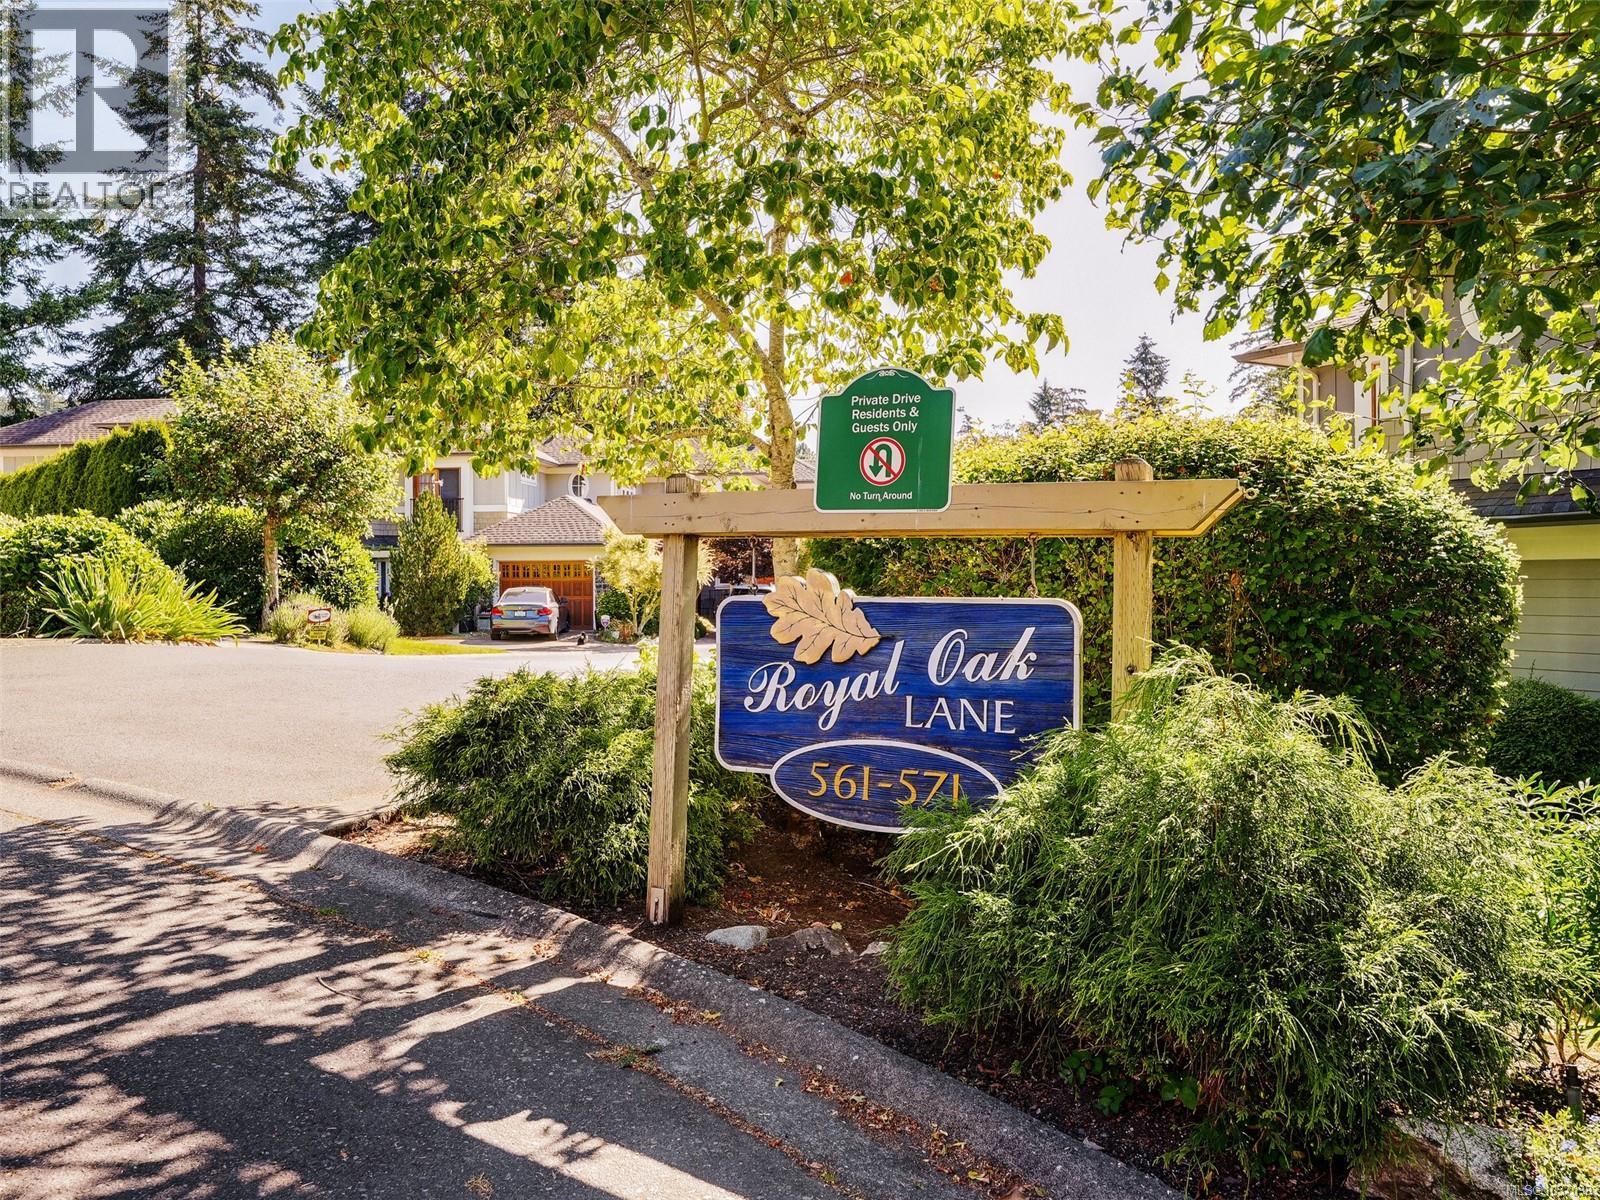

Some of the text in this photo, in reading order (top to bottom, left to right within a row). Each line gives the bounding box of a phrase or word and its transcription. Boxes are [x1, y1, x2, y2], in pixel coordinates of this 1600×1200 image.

[851, 393, 921, 406] Private Drive
[851, 406, 919, 420] Residents &
[851, 420, 918, 433] Guests Only
[849, 491, 913, 501] No Turn Around
[743, 626, 1039, 732] Royal Oak
[904, 695, 1017, 735] LANE
[807, 761, 961, 811] 561-571
